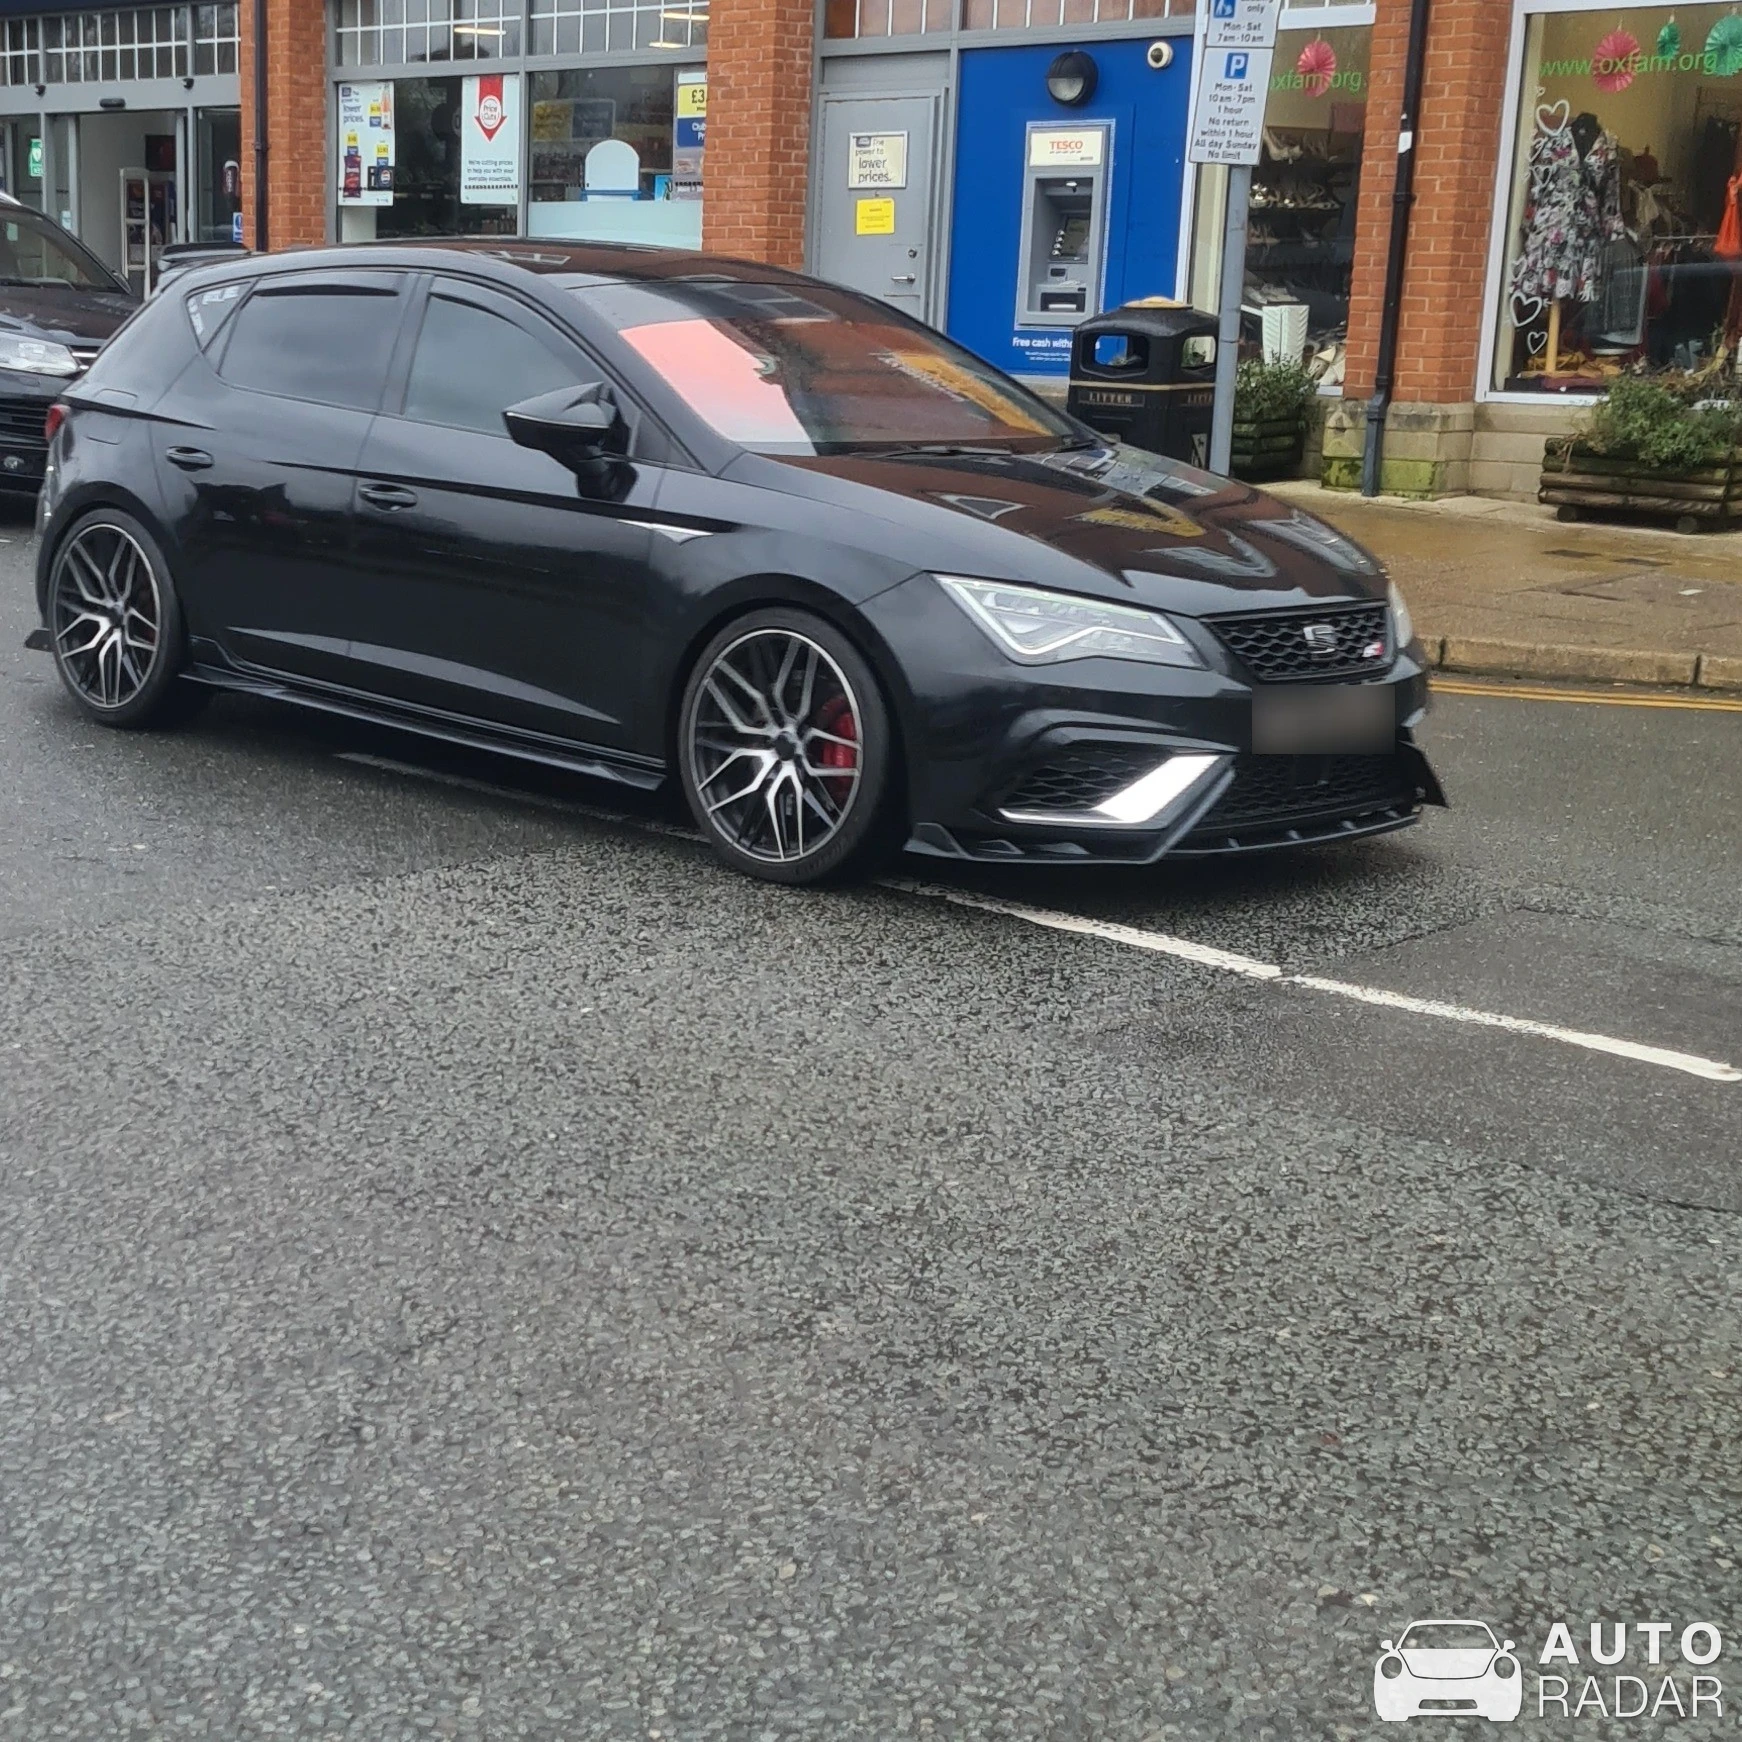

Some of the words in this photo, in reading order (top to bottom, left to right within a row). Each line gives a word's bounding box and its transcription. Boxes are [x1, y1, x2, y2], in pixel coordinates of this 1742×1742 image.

[1247, 4, 1265, 14] only
[483, 104, 498, 113] Price
[1224, 105, 1243, 114] hour
[483, 112, 497, 121] Cuts
[1208, 116, 1220, 125] No
[1222, 118, 1250, 126] return
[1200, 128, 1226, 137] within
[1235, 129, 1254, 139] hour
[1048, 140, 1084, 151] TESCO
[1194, 138, 1207, 148] All
[1208, 140, 1224, 150] day
[1225, 140, 1258, 150] Sunday
[1207, 150, 1220, 159] No
[1221, 151, 1241, 160] limit
[858, 157, 888, 169] lower
[1012, 336, 1031, 347] Free
[1031, 337, 1051, 348] cash
[1089, 392, 1133, 404] LITTER
